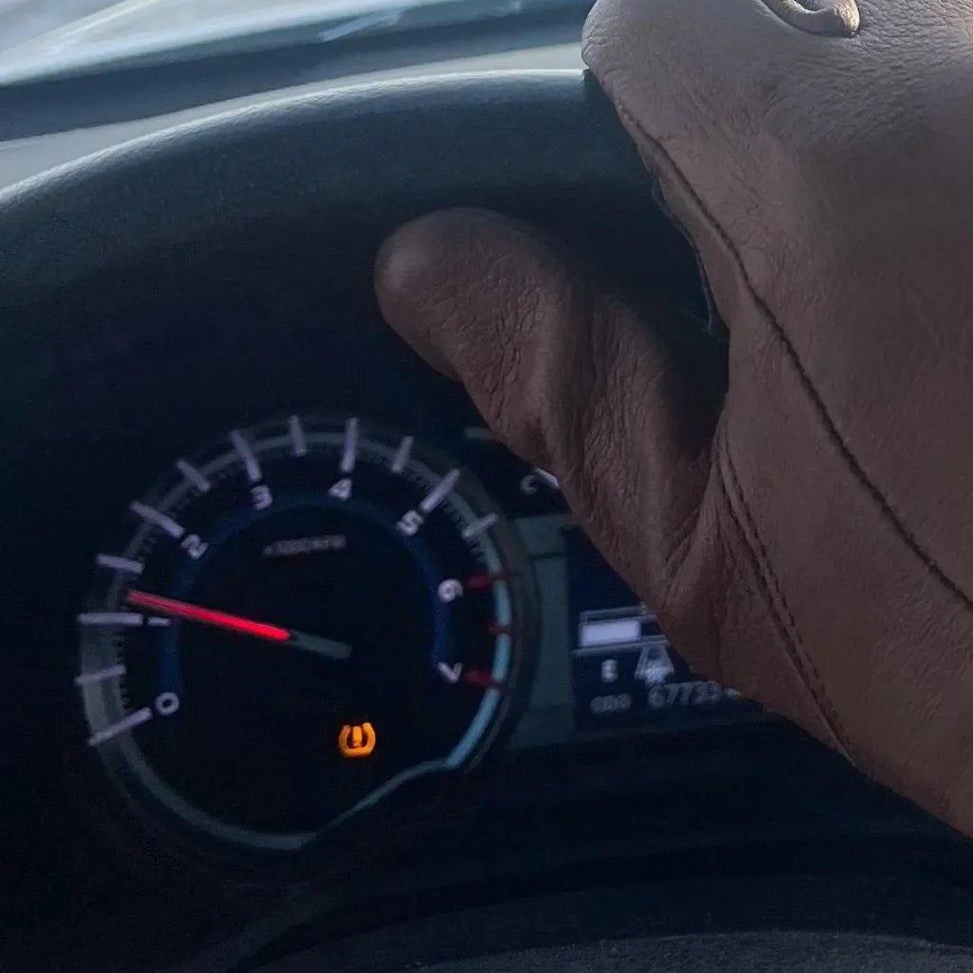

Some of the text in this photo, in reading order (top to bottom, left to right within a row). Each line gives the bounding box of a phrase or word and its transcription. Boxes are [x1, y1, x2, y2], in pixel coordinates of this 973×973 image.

[251, 485, 273, 510] 3
[328, 477, 353, 501] 4
[397, 511, 424, 536] 5
[181, 534, 209, 559] 2
[438, 578, 464, 602] 6
[437, 661, 463, 685] 7
